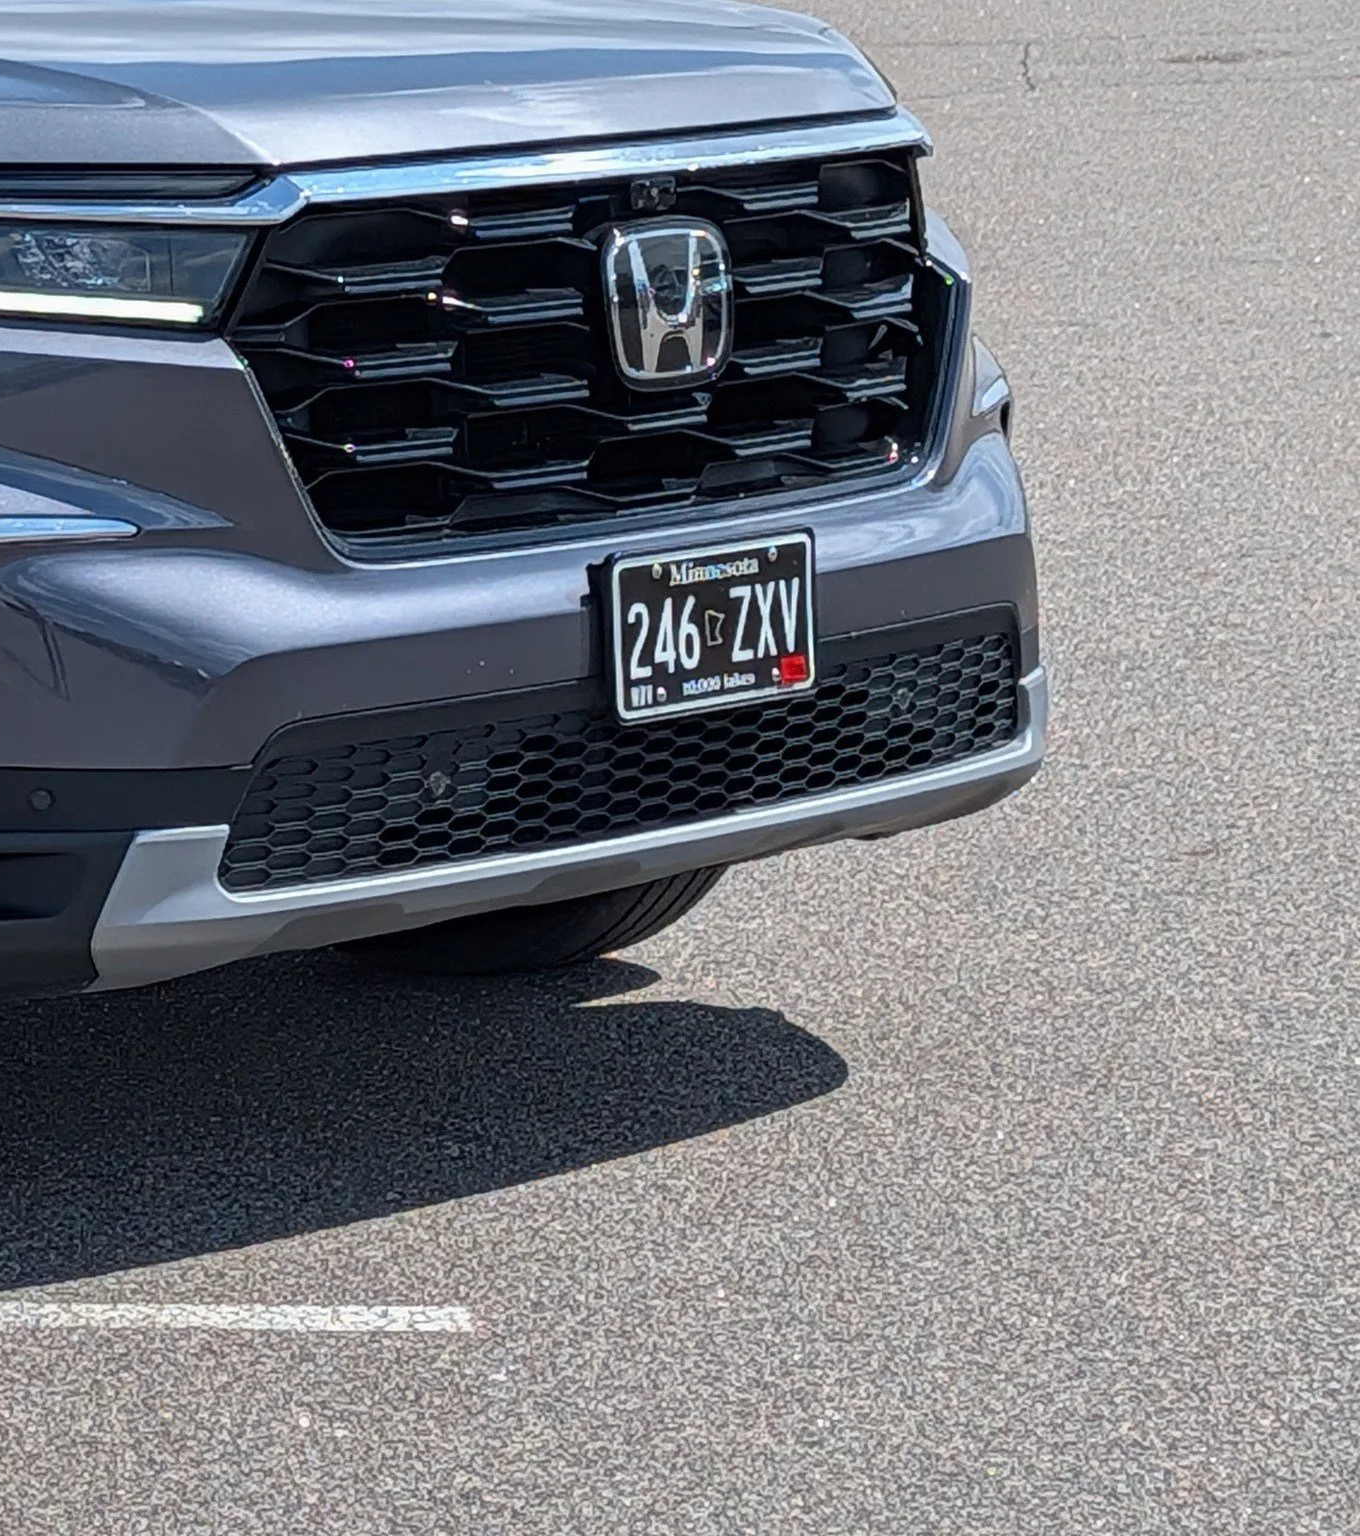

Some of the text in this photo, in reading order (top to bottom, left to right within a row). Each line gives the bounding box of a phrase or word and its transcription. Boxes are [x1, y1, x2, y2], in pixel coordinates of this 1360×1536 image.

[669, 557, 759, 587] Minnesota
[627, 577, 800, 680] 246 ZXV
